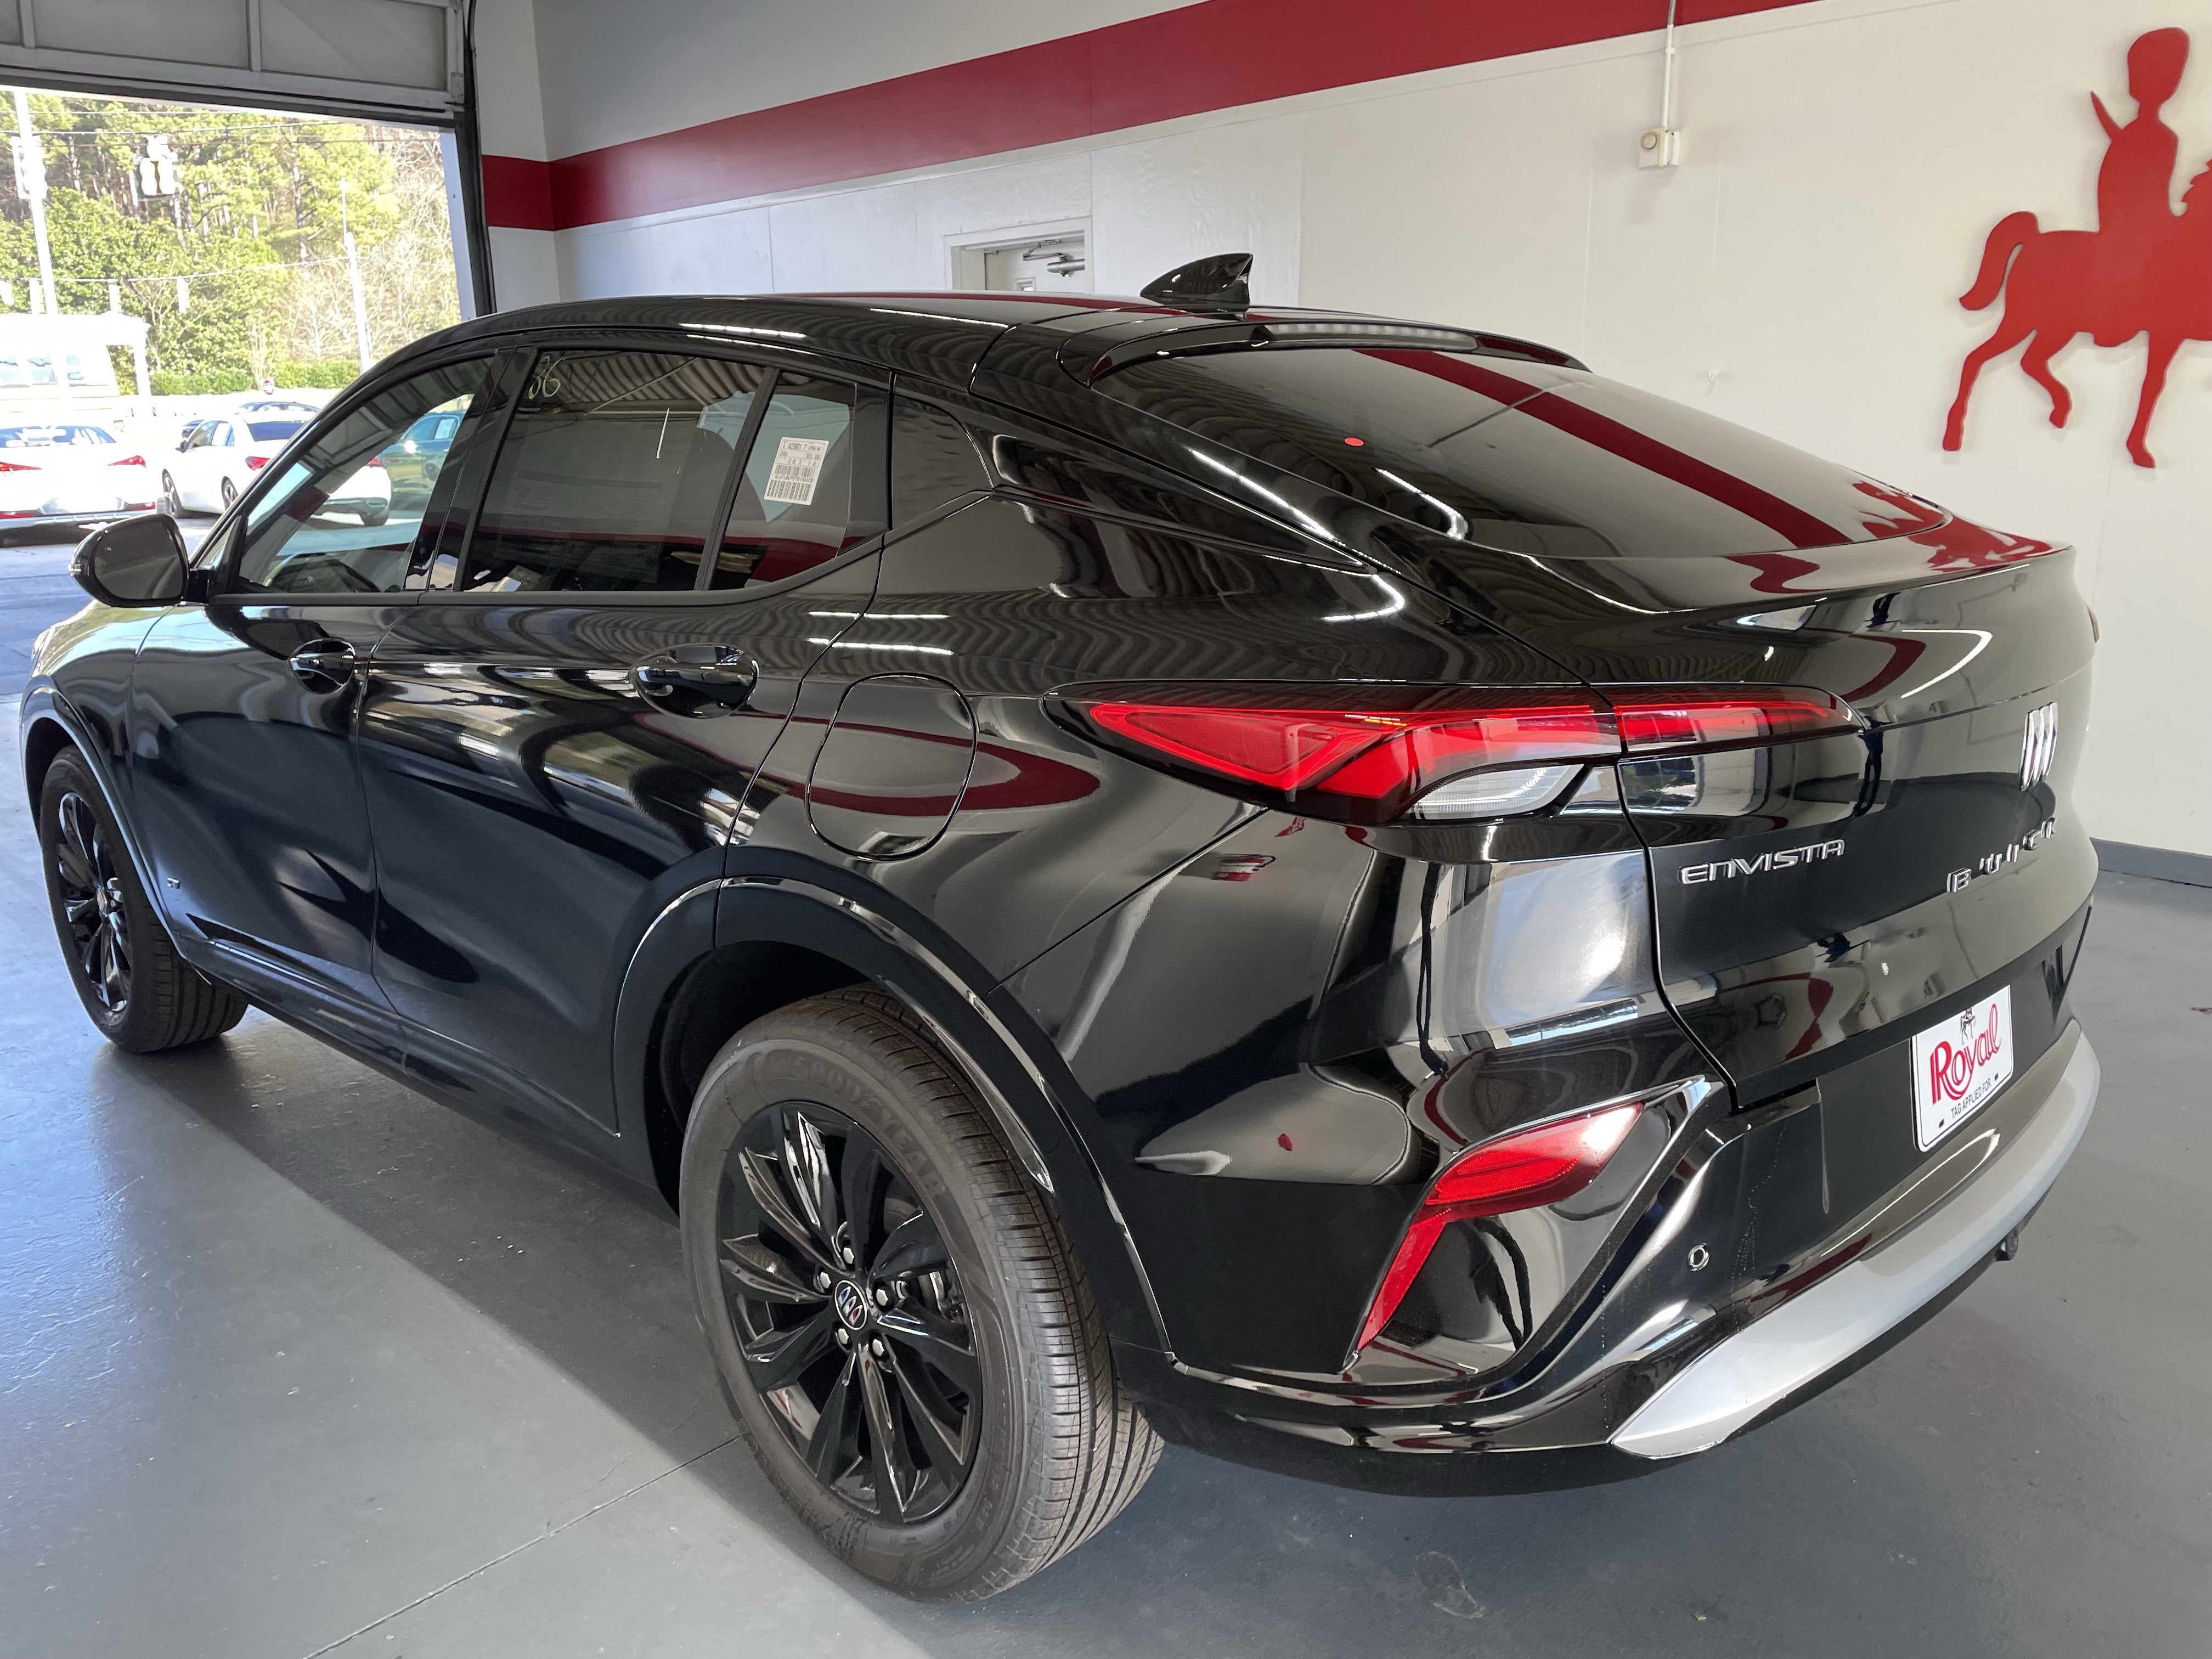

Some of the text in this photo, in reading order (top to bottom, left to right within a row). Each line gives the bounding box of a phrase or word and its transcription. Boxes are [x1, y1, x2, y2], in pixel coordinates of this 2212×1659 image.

[1679, 839, 1845, 884] ENVISTA
[1946, 816, 2056, 893] BUICK
[1930, 1003, 2002, 1105] Royal
[1951, 1077, 1992, 1119] TAG APPLIED FOR
